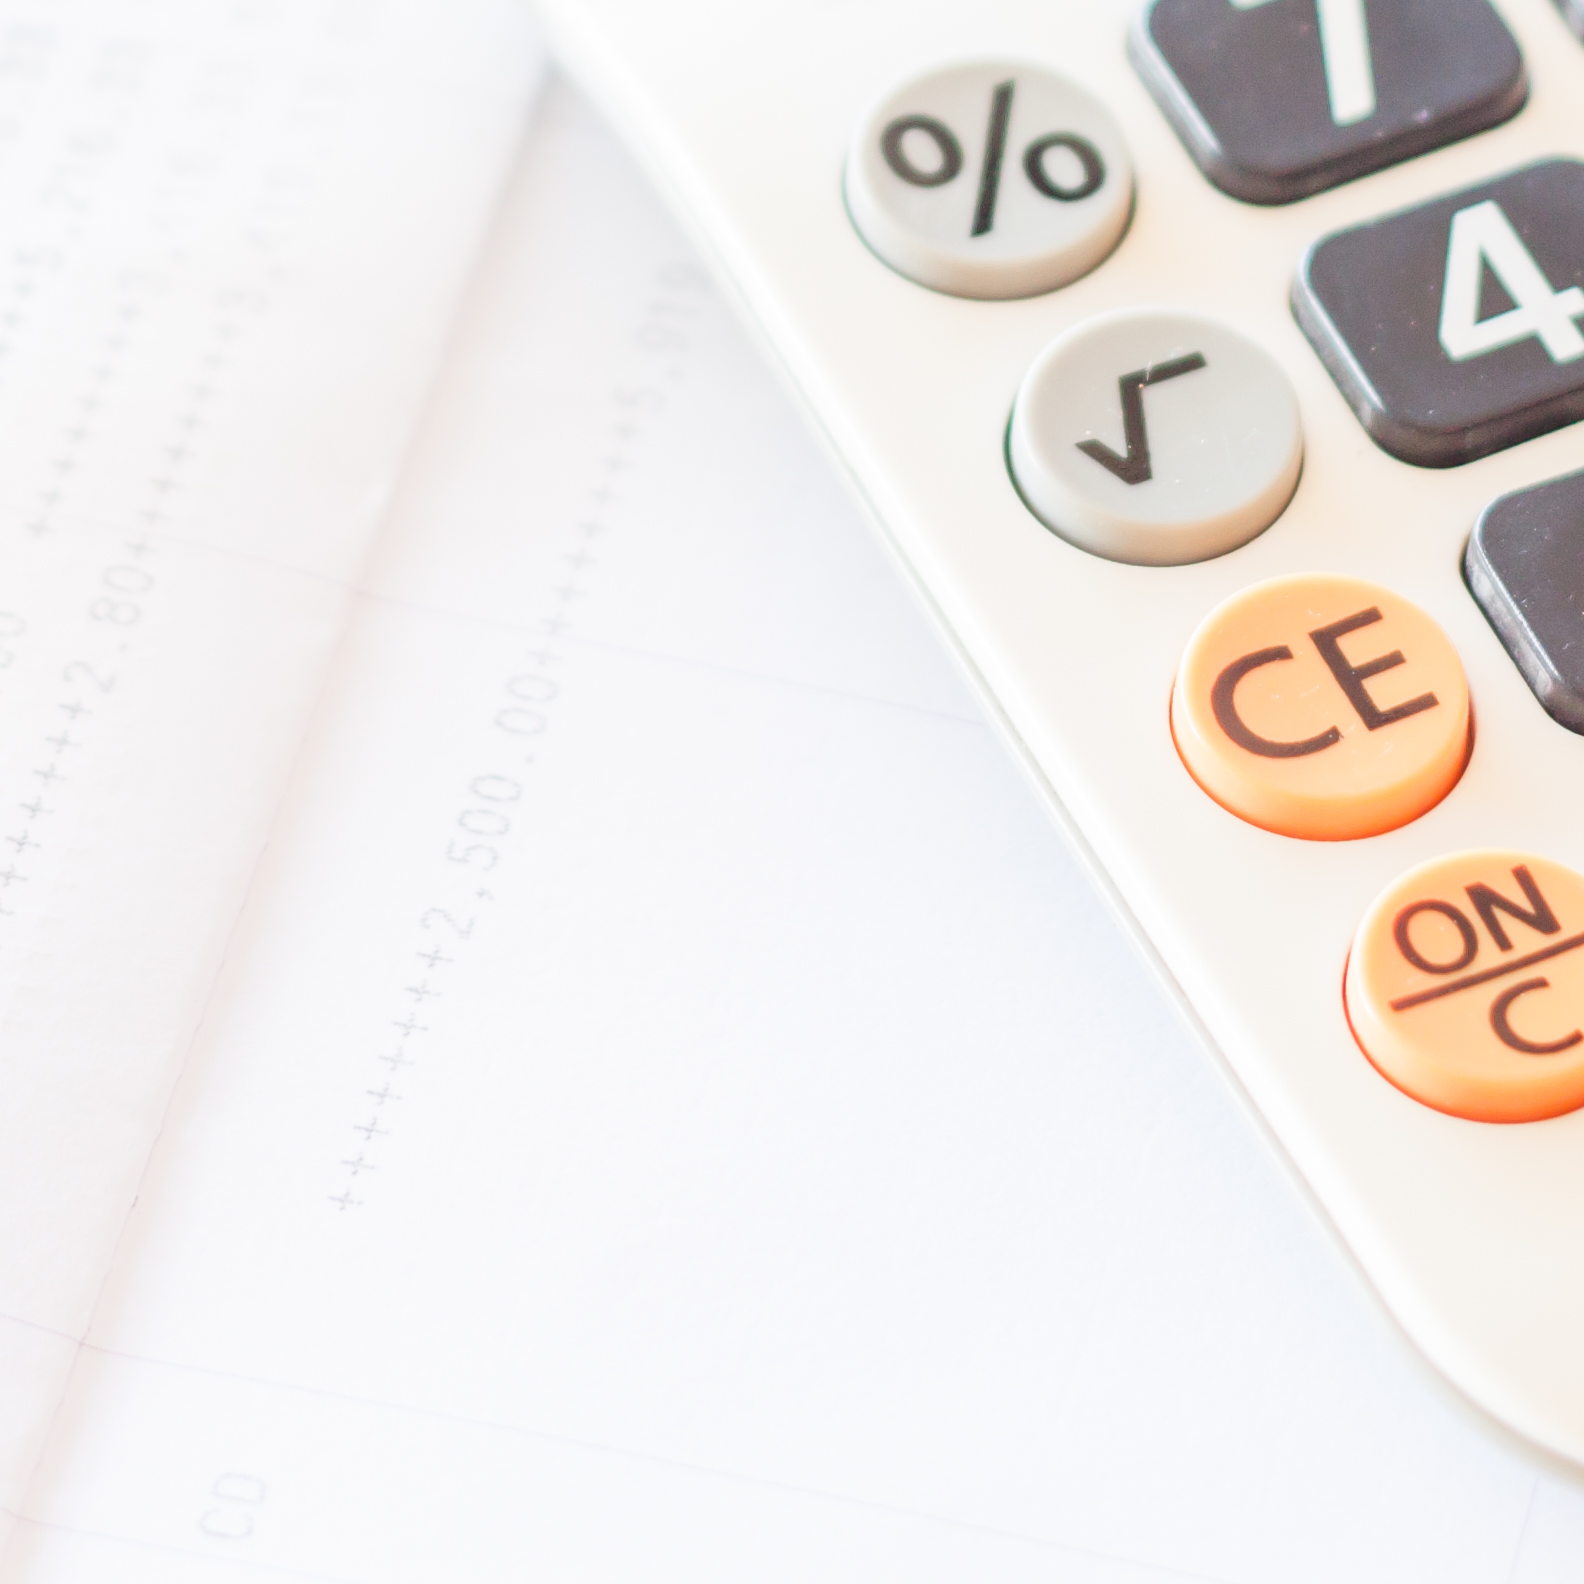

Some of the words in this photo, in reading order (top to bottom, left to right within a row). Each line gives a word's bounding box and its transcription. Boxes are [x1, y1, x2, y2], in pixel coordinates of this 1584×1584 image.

[880, 78, 1107, 239] %
[1209, 605, 1441, 759] CE
[1392, 864, 1563, 976] ON
[198, 1471, 269, 1543] CD
